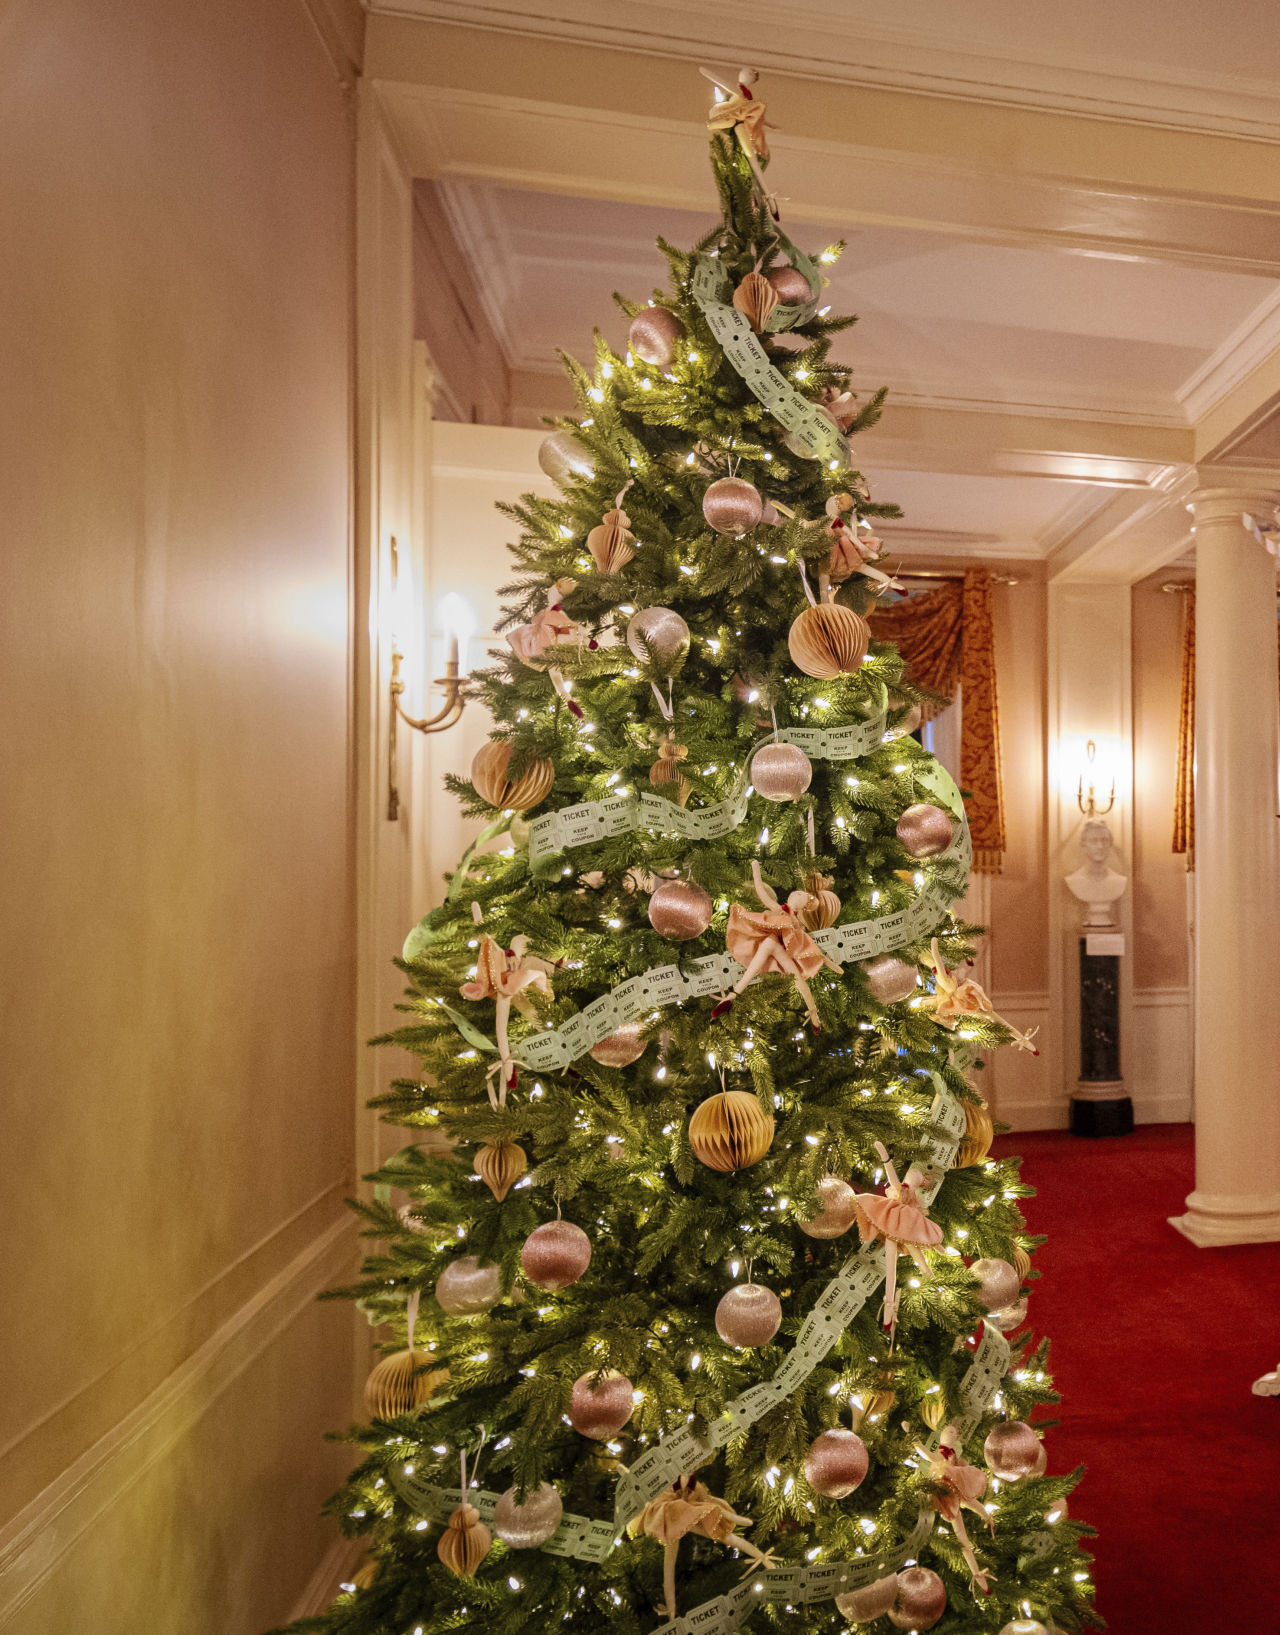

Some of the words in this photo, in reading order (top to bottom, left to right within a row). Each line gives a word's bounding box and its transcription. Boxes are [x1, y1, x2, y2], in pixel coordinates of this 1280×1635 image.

[744, 337, 761, 360] TICKET
[767, 370, 785, 390] TICKET
[790, 397, 808, 413] TICKET
[812, 417, 831, 434] TICKET
[828, 731, 853, 739] TICKET
[603, 801, 629, 812] TICKET
[641, 799, 662, 809] TICKET
[562, 809, 590, 822] TICKET
[697, 808, 724, 820] TICKET
[533, 820, 551, 833] TICKET
[880, 917, 904, 930] TICKET
[842, 927, 868, 938] TICKET
[648, 971, 675, 983] TICKET
[698, 977, 713, 985] KEEP
[614, 984, 636, 1001] TICKET
[696, 985, 719, 993] COUPON
[656, 994, 679, 1002] COUPON
[587, 1003, 606, 1020] TICKET
[562, 1021, 580, 1037] TICKET
[526, 1037, 553, 1051] TICKET
[936, 1103, 949, 1125] TICKET
[845, 1261, 863, 1279] TICKET
[821, 1286, 842, 1310] TICKET
[839, 1300, 849, 1313] KEEP
[843, 1303, 859, 1321] COUPON
[800, 1320, 817, 1346] TICKET
[776, 1357, 797, 1380] TICKET
[963, 1373, 979, 1396] TICKET
[741, 1386, 767, 1403] TICKET
[665, 1431, 691, 1451] TICKET
[633, 1457, 656, 1478] TICKET
[480, 1498, 497, 1508] TICK
[590, 1527, 615, 1537] TICKET
[850, 1560, 875, 1571] TICKET
[809, 1569, 836, 1579] TICKET
[691, 1605, 719, 1625] TICKET
